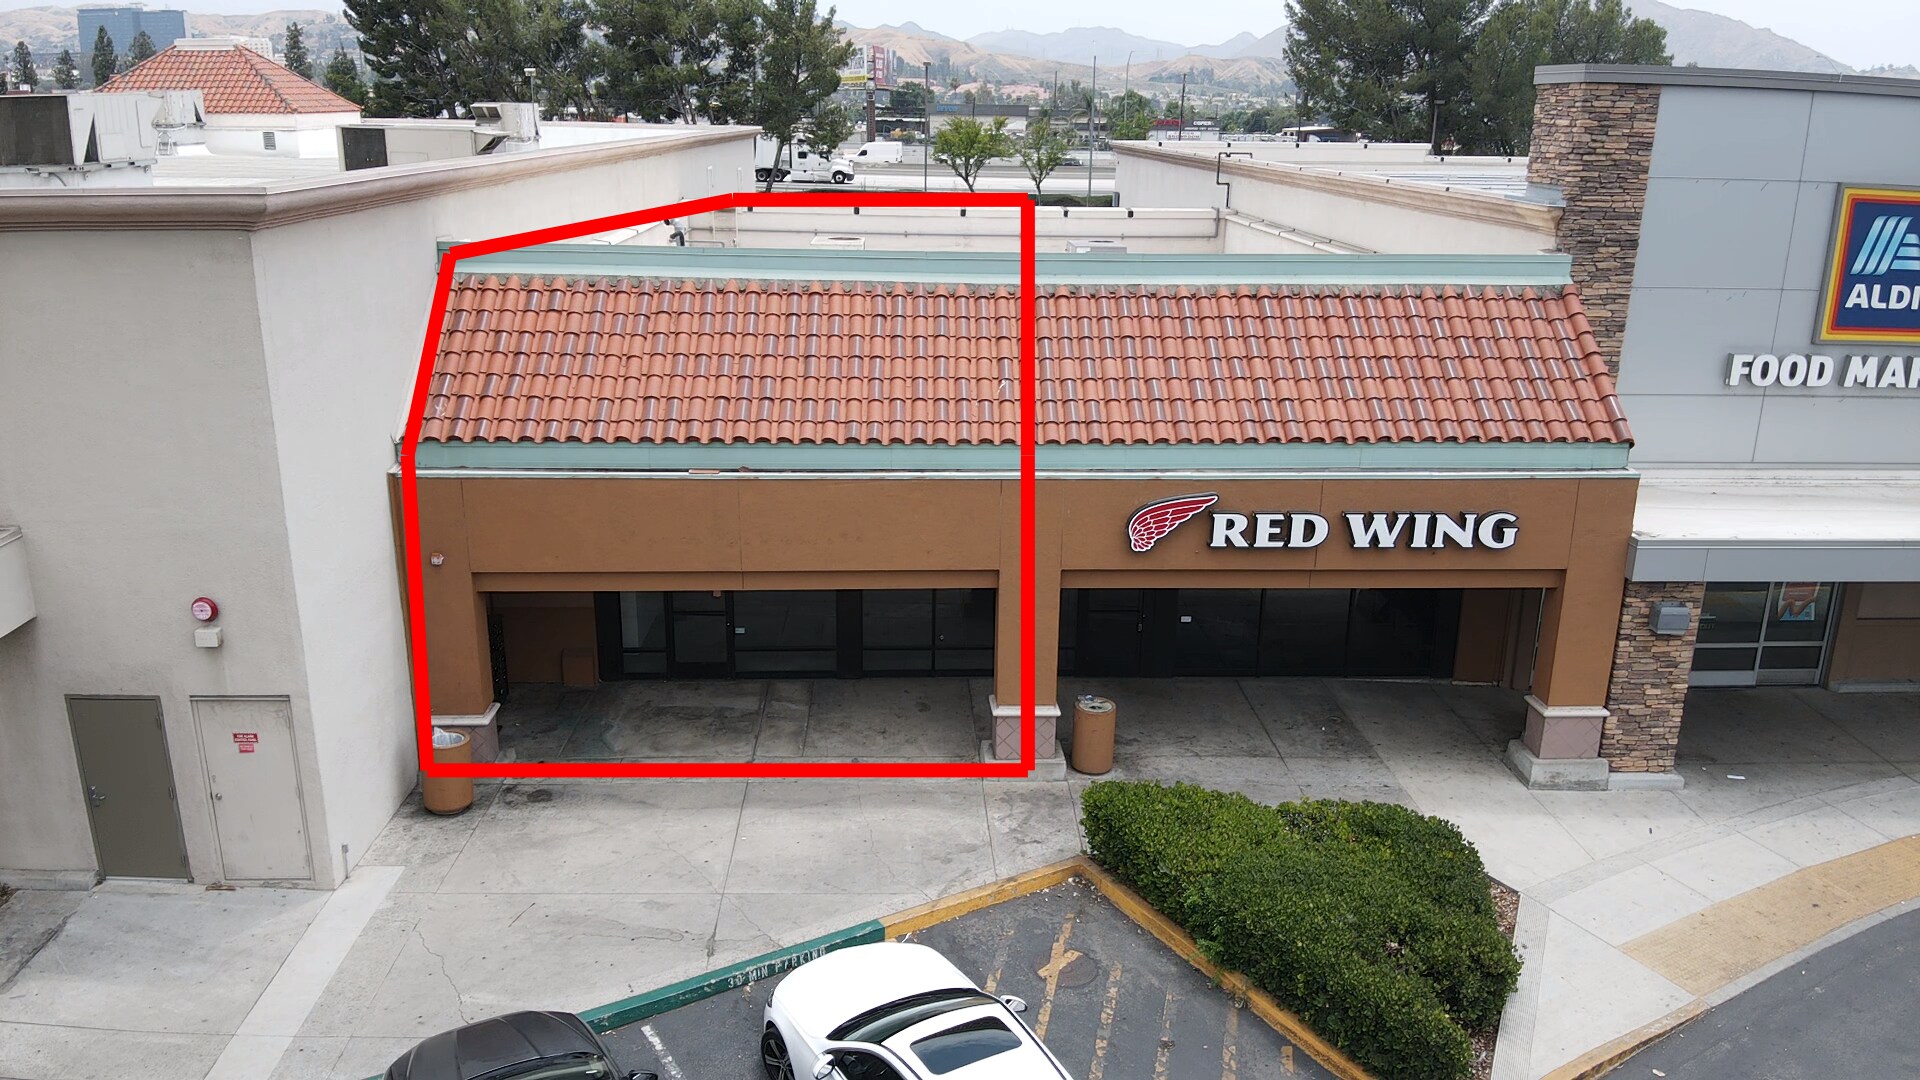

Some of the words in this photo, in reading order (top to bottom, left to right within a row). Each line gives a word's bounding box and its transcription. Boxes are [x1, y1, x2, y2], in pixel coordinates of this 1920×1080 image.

[1844, 283, 1920, 310] ALDI
[1728, 353, 1835, 388] FOOD
[1208, 511, 1330, 549] RED
[1344, 511, 1520, 550] WING
[727, 974, 743, 988] 30
[748, 965, 769, 982] MIN
